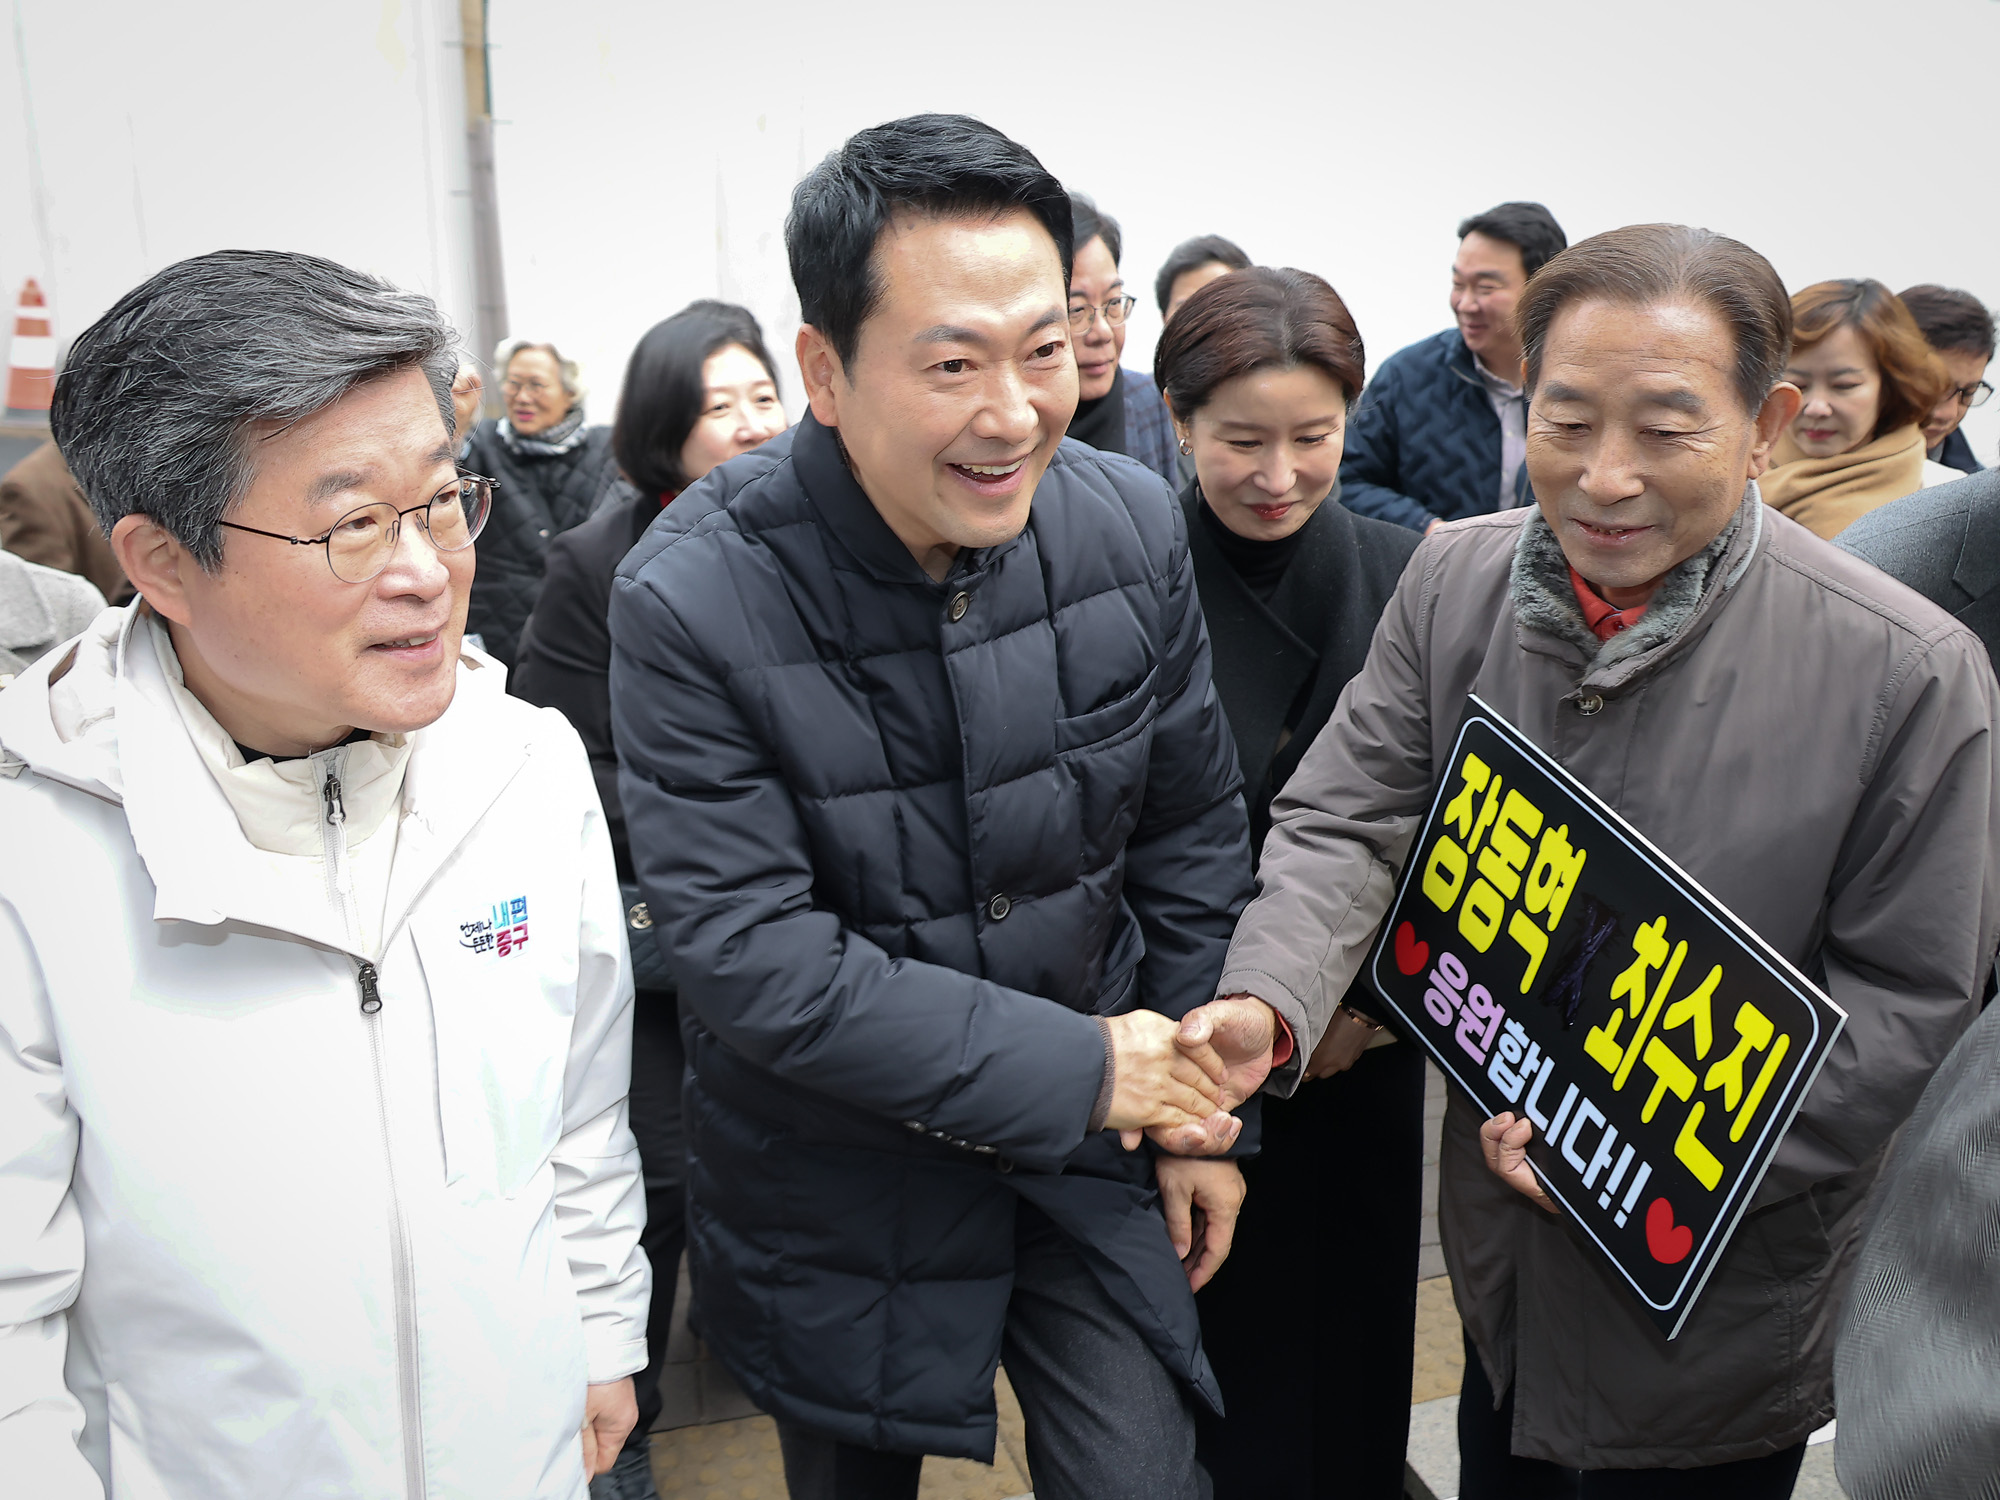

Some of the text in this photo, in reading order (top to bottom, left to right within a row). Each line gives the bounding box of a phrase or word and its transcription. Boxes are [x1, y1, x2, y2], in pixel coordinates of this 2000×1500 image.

[460, 918, 492, 938] 언제나
[493, 895, 528, 929] 내편
[496, 922, 529, 958] 중구
[1422, 752, 1587, 995] 장동혁
[1584, 915, 1791, 1192] 최수진
[1424, 951, 1654, 1230] 응원합니다!!
